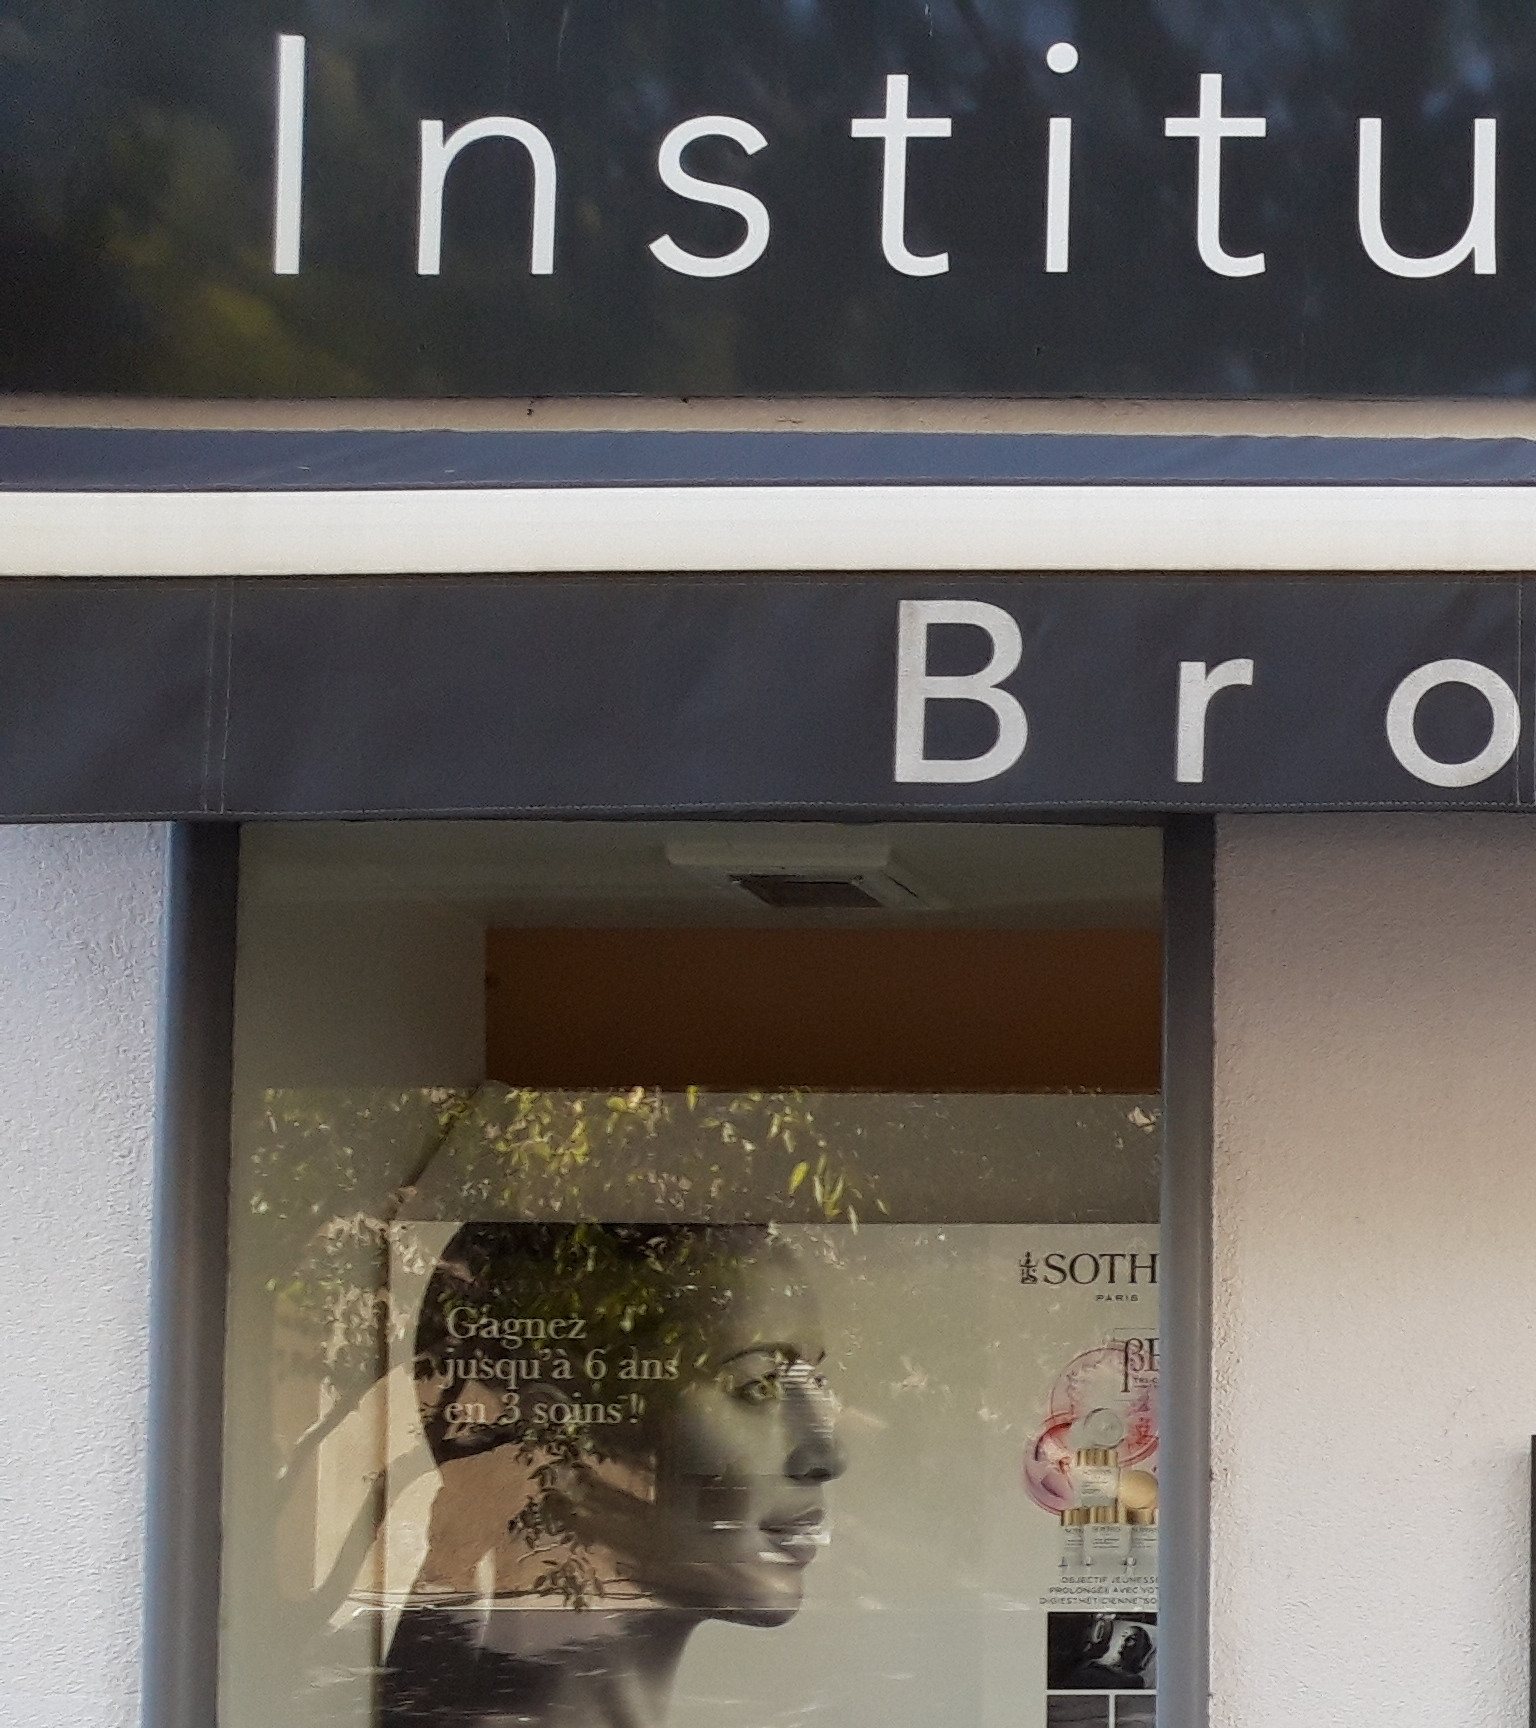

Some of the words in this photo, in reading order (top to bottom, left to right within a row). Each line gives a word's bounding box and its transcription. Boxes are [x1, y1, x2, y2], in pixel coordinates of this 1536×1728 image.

[447, 1306, 587, 1349] Gagnez
[439, 1348, 574, 1391] jusqu'à
[585, 1349, 608, 1380] 6
[617, 1357, 680, 1380] ans
[445, 1402, 487, 1424] en
[500, 1392, 521, 1425] 3
[533, 1391, 623, 1424] soins
